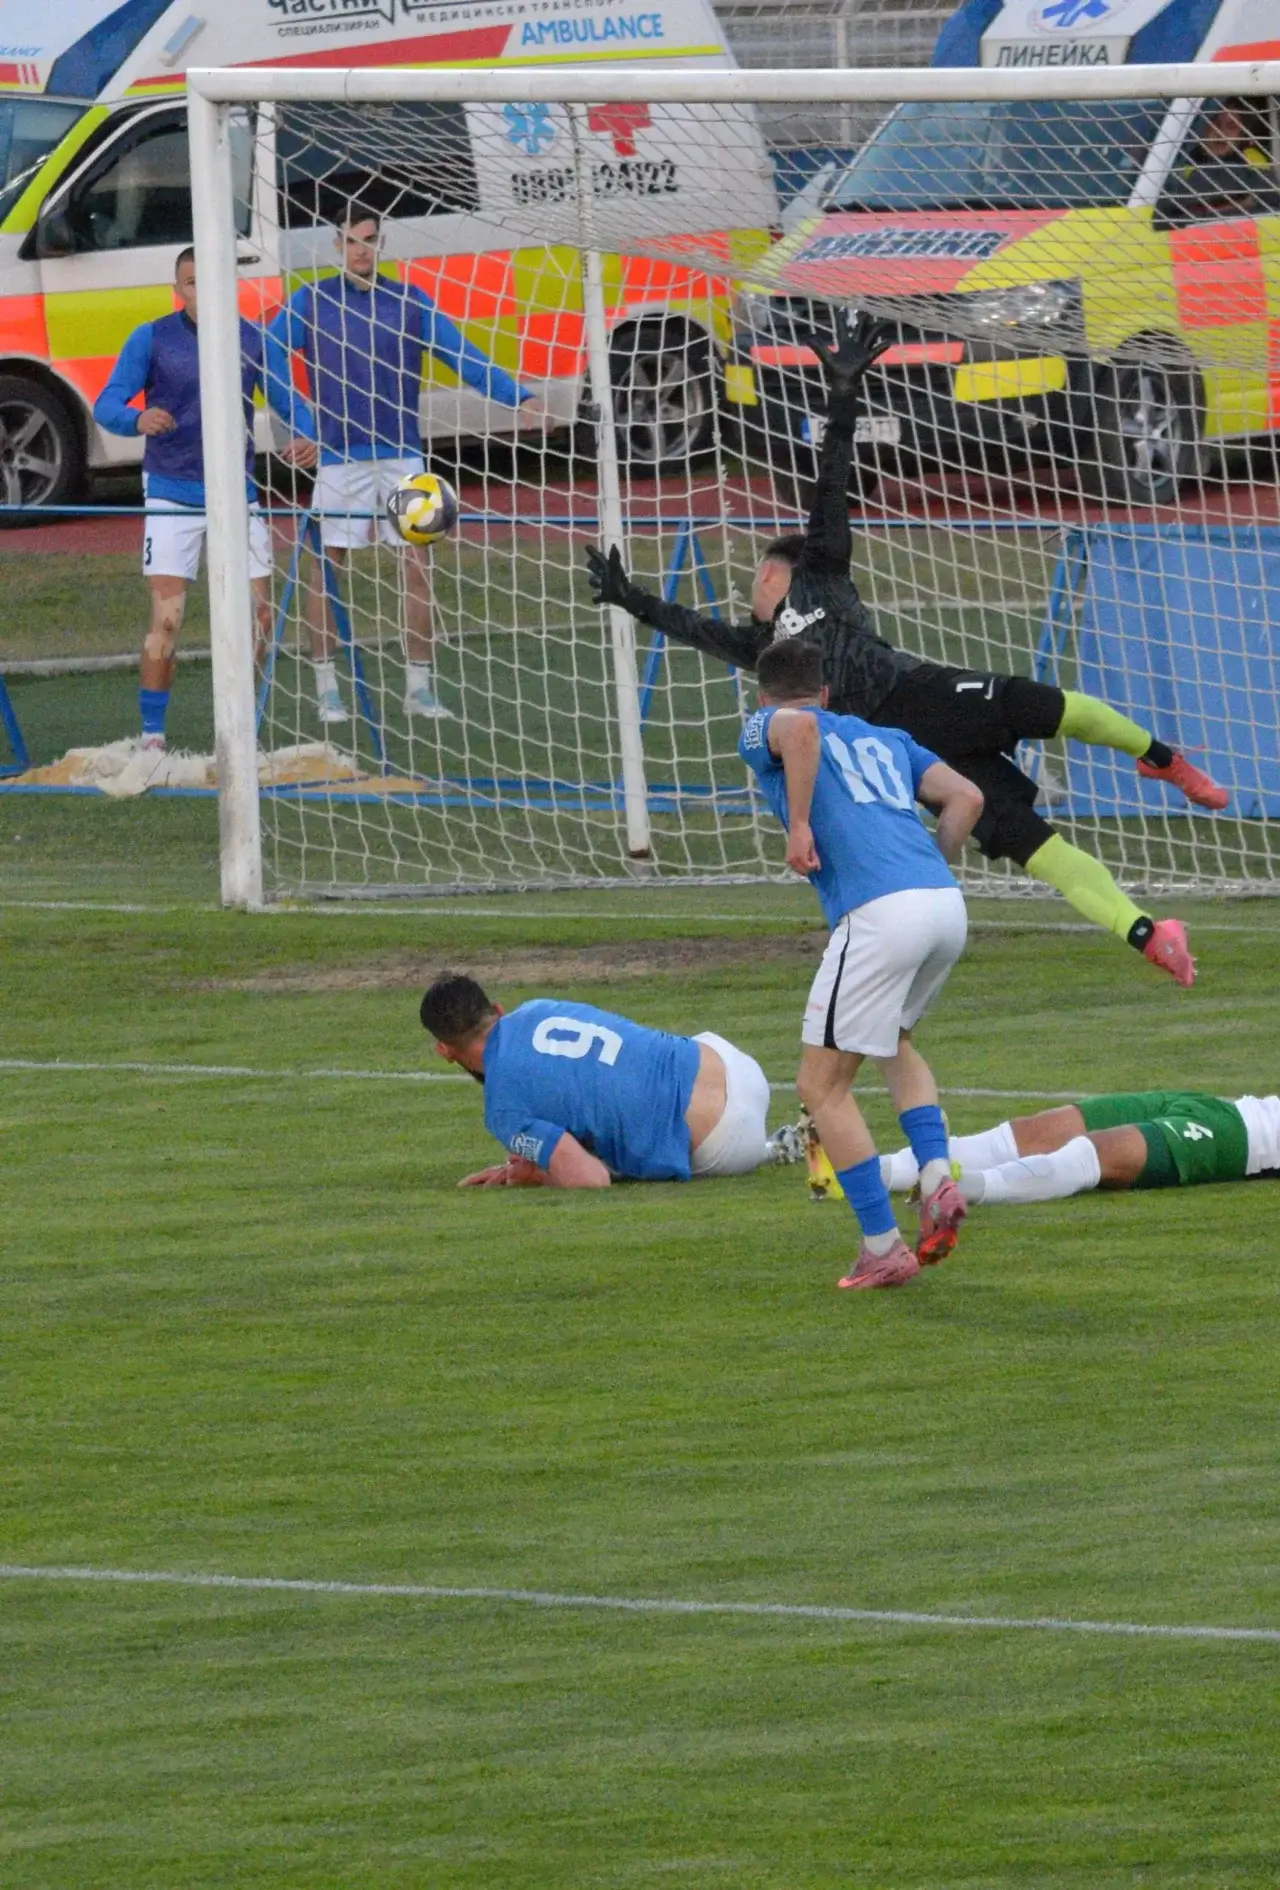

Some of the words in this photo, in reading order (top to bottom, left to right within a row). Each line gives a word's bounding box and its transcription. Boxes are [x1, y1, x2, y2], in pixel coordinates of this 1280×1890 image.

[278, 20, 380, 37] СПЕЦИАЛИЗИРАН
[521, 14, 664, 45] AMBULANCE
[995, 40, 1109, 66] ЛИНЕЙКА
[955, 682, 984, 693] 1
[824, 732, 912, 810] 10
[532, 1016, 624, 1067] 9
[1183, 1121, 1214, 1141] 4
